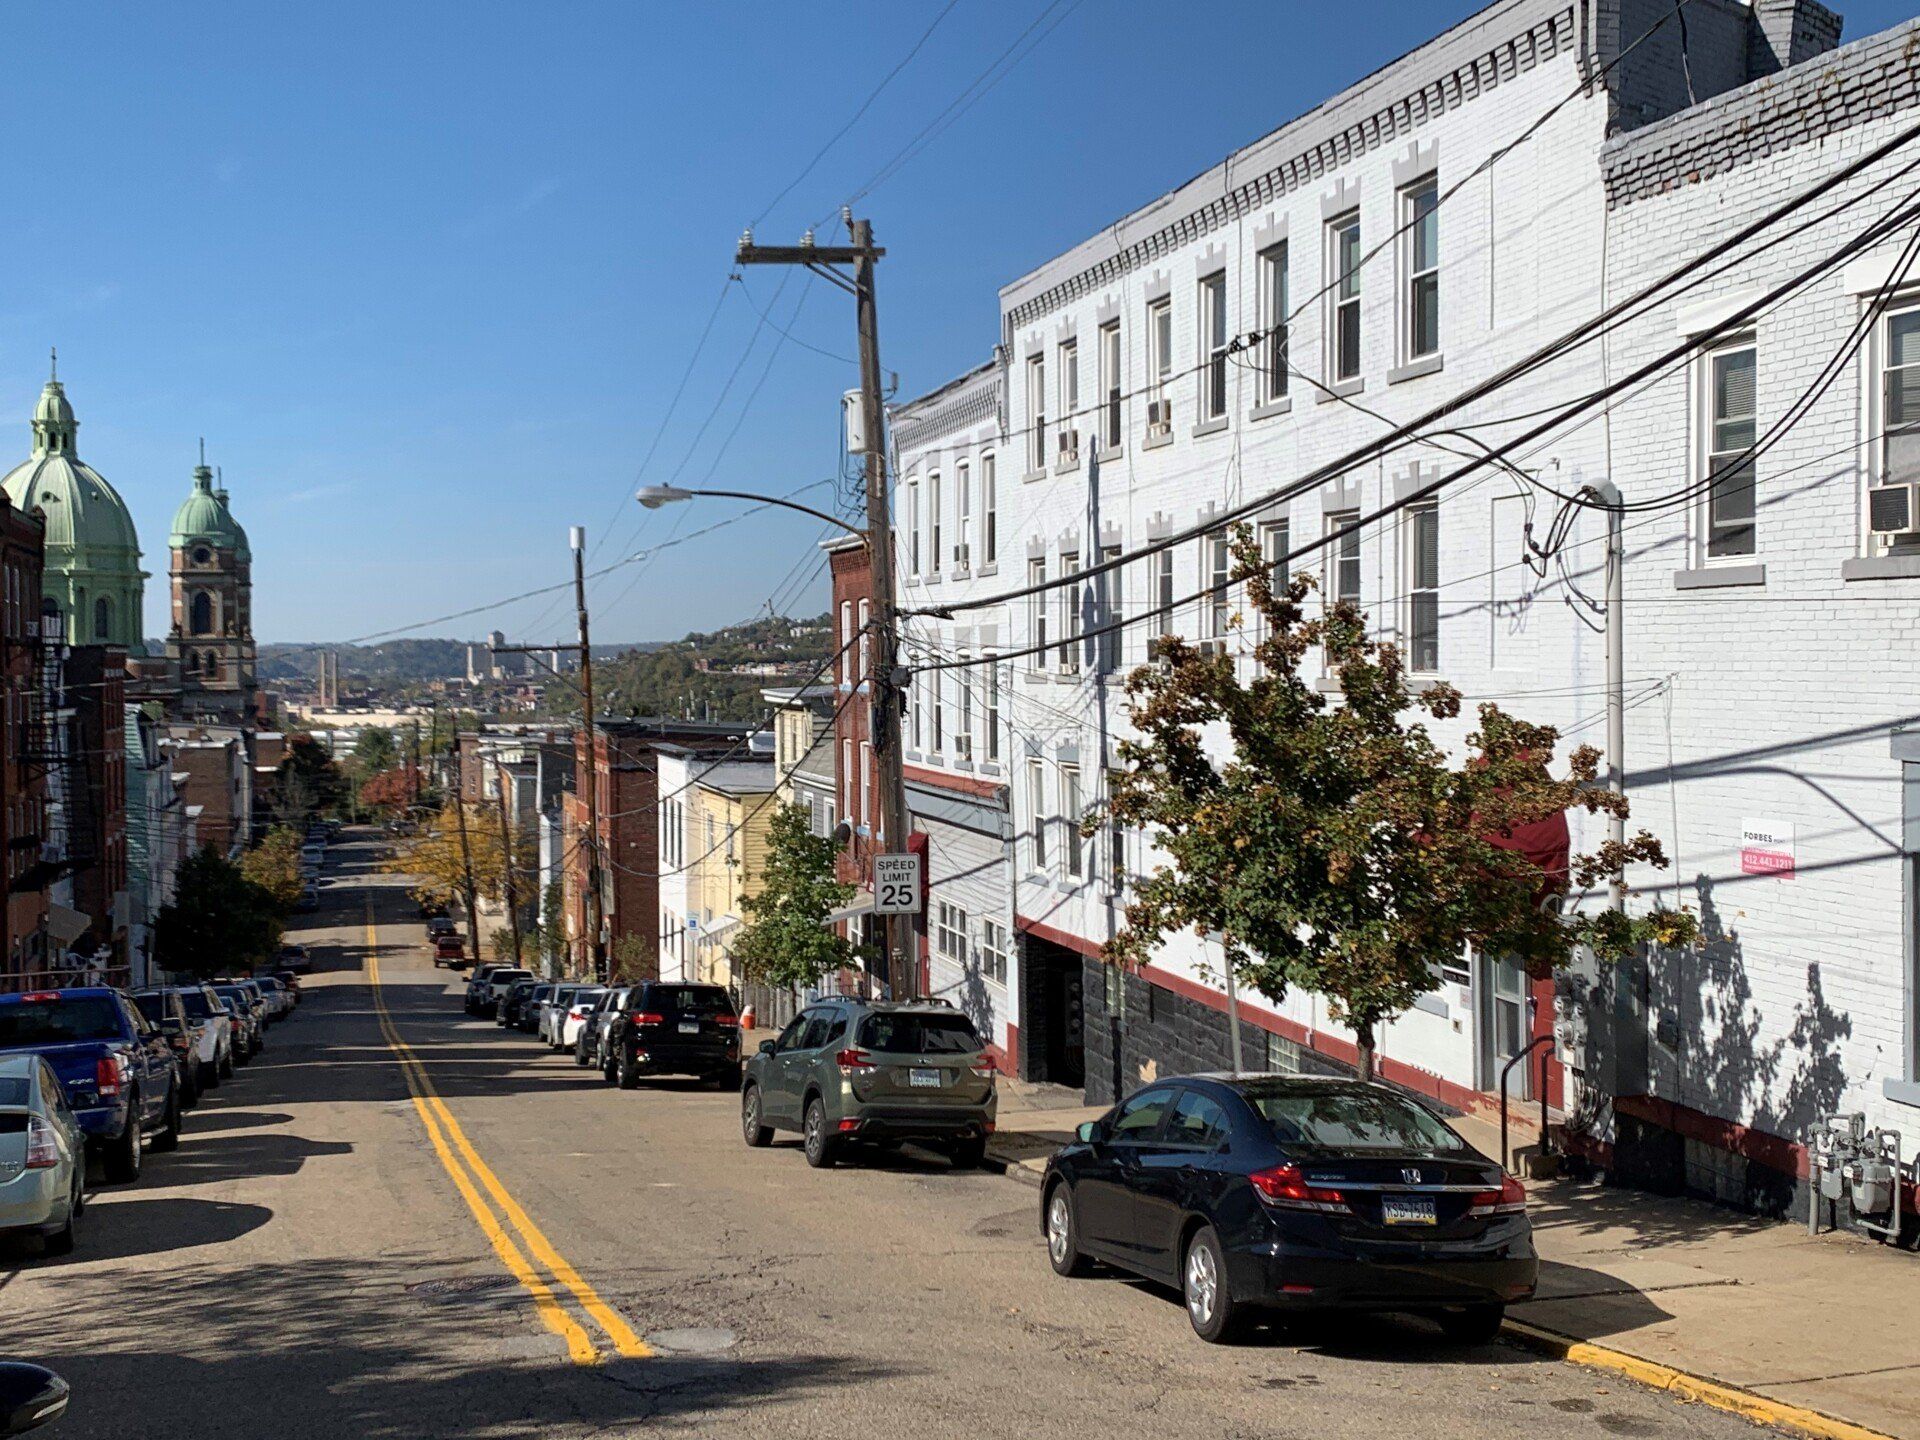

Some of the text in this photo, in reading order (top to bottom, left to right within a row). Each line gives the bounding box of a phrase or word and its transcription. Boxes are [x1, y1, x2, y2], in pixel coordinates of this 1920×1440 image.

[1744, 832, 1773, 843] FORBES
[877, 860, 916, 870] SPEED
[882, 872, 911, 882] LIMIT
[881, 884, 913, 906] 25
